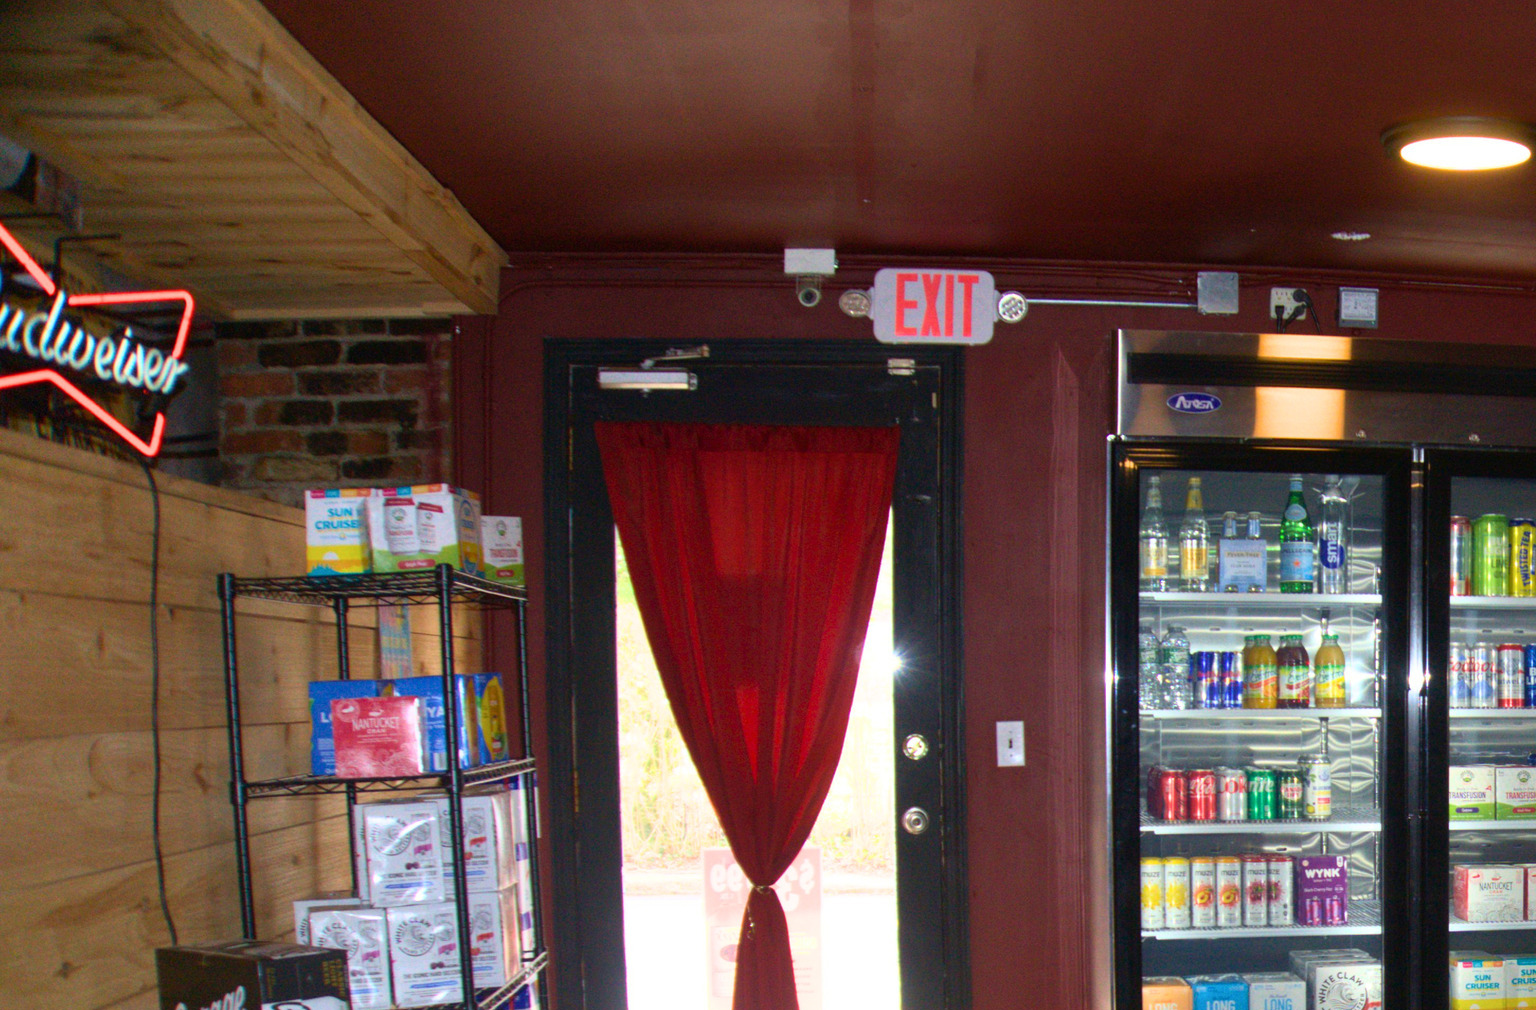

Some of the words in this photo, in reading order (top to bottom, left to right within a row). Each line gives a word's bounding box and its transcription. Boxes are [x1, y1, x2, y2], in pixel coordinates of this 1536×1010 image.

[895, 274, 980, 337] EXIT
[327, 508, 353, 517] SUN
[315, 519, 362, 530] CRUISE
[1326, 521, 1338, 564] smart
[1523, 531, 1532, 547] TEA
[1519, 548, 1531, 587] TWISTED
[352, 716, 400, 732] NANTUCKET
[1249, 776, 1274, 793] rite
[1449, 791, 1486, 799] TRANSFUSION
[1304, 868, 1340, 879] WYNK
[1479, 881, 1513, 891] NANTUCKET
[1319, 974, 1336, 1004] WHITE
[1337, 971, 1364, 986] CLAW
